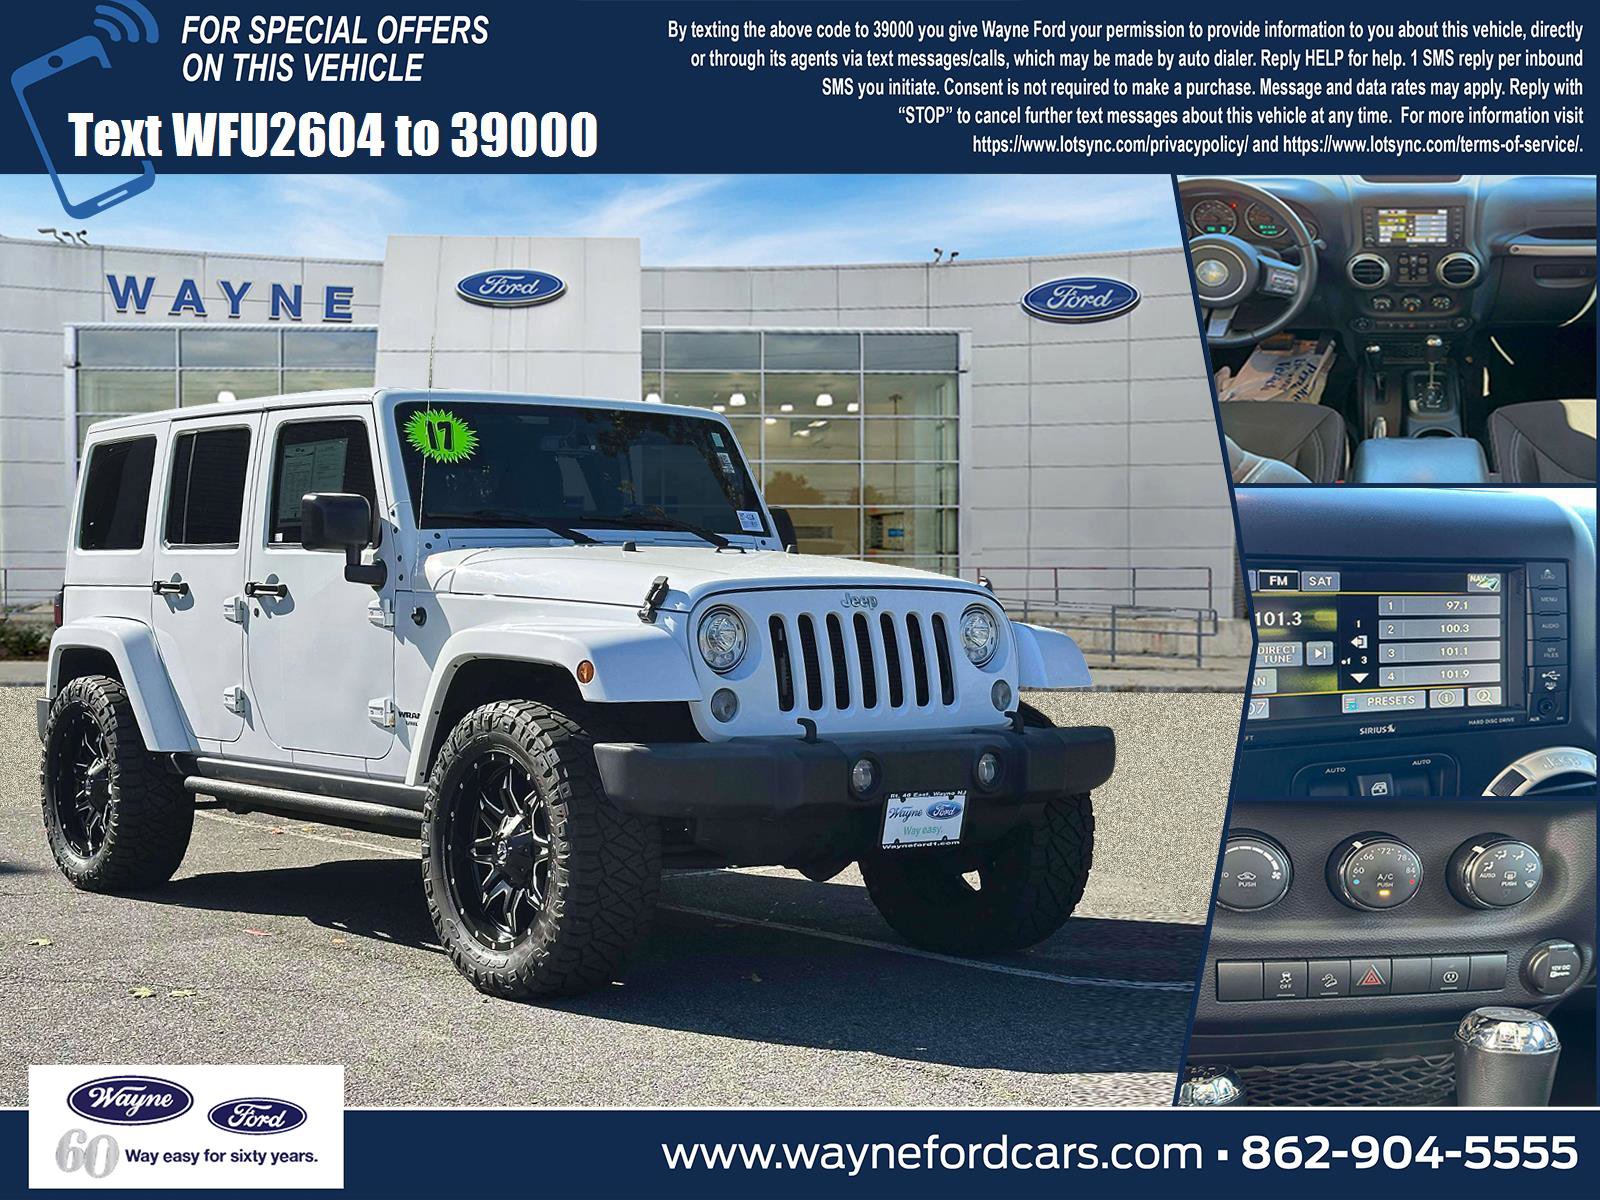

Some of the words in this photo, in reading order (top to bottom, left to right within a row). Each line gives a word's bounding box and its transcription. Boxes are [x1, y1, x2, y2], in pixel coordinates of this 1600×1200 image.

[479, 275, 540, 295] Ford
[106, 274, 355, 322] WAYNE
[1046, 284, 1114, 309] Ford
[1269, 575, 1288, 586] FM
[1308, 576, 1333, 587] SAT
[841, 593, 878, 610] Jeep
[1446, 601, 1468, 610] 97.1
[1255, 611, 1302, 626] 101.3
[1388, 624, 1394, 634] 2
[1441, 624, 1470, 633] 100.3
[1258, 645, 1296, 655] DIRECT
[1388, 648, 1395, 657] 3
[1441, 647, 1468, 656] 101.1
[1264, 655, 1292, 664] TUNE
[1361, 656, 1367, 665] 3
[1387, 672, 1395, 681] 4
[1441, 670, 1470, 679] 101.9
[1367, 695, 1416, 706] PRESETS
[1360, 726, 1387, 735] SIRIUS
[888, 807, 922, 823] Wayne
[933, 803, 956, 816] Ford
[904, 826, 921, 836] Way
